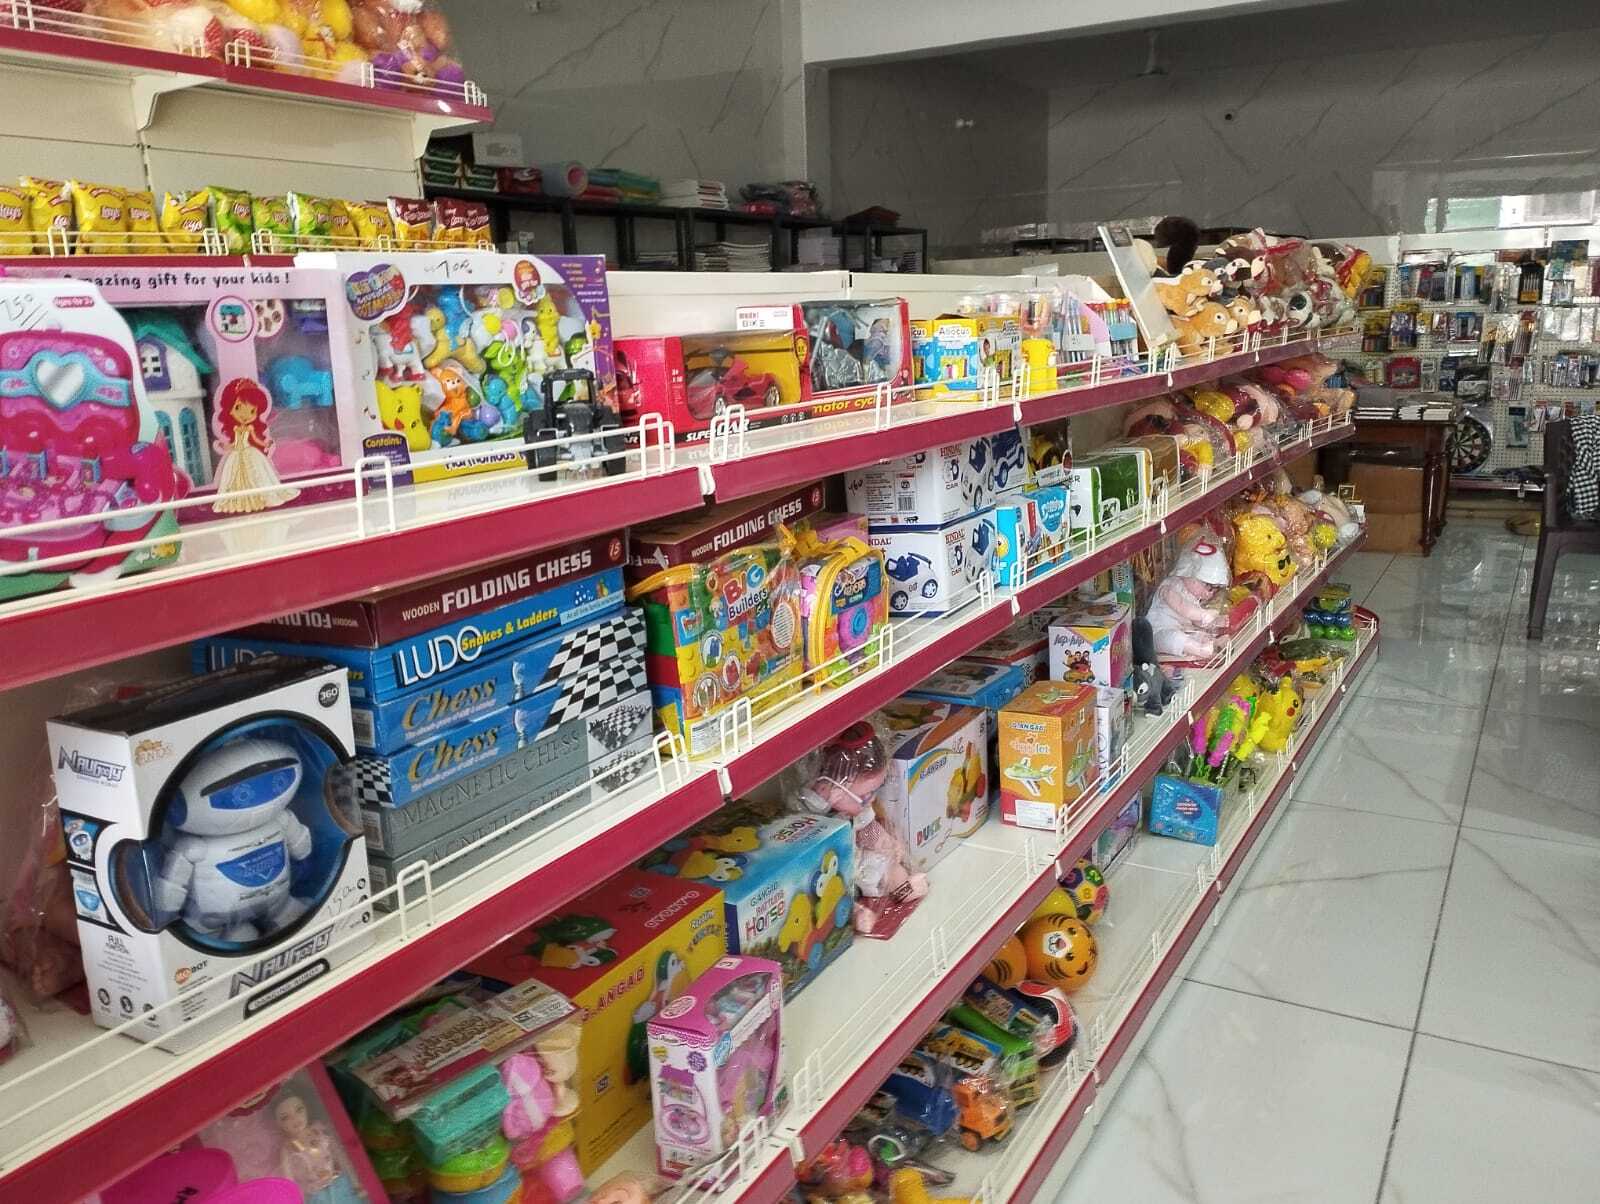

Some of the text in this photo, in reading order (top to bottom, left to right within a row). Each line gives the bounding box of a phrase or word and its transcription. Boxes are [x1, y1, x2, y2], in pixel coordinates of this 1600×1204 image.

[148, 273, 177, 289] gift
[184, 273, 206, 286] for
[212, 275, 245, 288] your
[250, 272, 280, 284] kids
[812, 399, 851, 414] motor
[713, 514, 765, 552] FOLDING
[768, 498, 802, 525] CHESS
[402, 601, 440, 622] WOODEN
[442, 568, 531, 614] FOLDING
[536, 549, 592, 583] CHESS
[727, 586, 768, 621] Builders
[460, 606, 559, 651] Snakes & Ladders
[398, 625, 485, 687] LUDO
[319, 687, 338, 701] 360
[402, 676, 498, 731] Chess
[401, 757, 518, 830] MAGNETIC
[522, 729, 579, 773] CHESS
[408, 725, 501, 783] Chess
